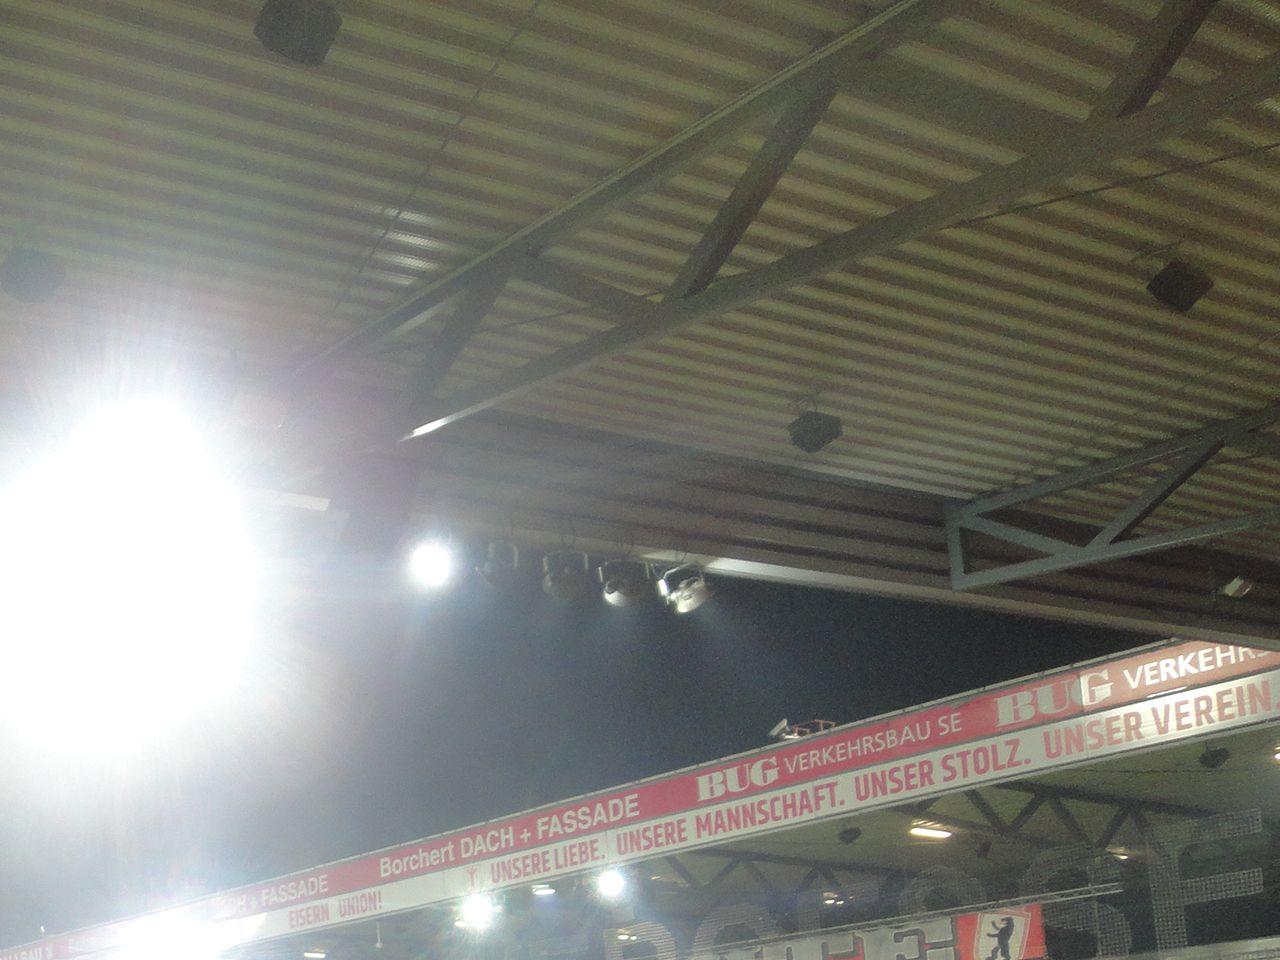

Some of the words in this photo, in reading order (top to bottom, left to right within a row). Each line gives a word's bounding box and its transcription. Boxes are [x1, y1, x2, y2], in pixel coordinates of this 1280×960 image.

[996, 670, 1113, 728] BUG
[1123, 645, 1270, 689] VERKEHR
[491, 852, 551, 884] UNSERE
[554, 838, 606, 869] LIEBE.
[617, 818, 688, 856] UNSERE
[696, 781, 846, 839] MANNSCHAFT.
[855, 760, 936, 802] UNSER
[943, 738, 1031, 783] STOLZ.
[1043, 711, 1145, 760] UNSER
[696, 757, 780, 801] BUG
[784, 721, 931, 774] VERKEHRSBAU
[939, 712, 962, 736] SE
[380, 841, 456, 879] Borchert
[461, 826, 514, 859] DACH
[537, 793, 640, 840] FASSADE
[261, 874, 329, 907] FASSADE
[288, 903, 330, 929] EISERN
[338, 890, 382, 918] UNION!
